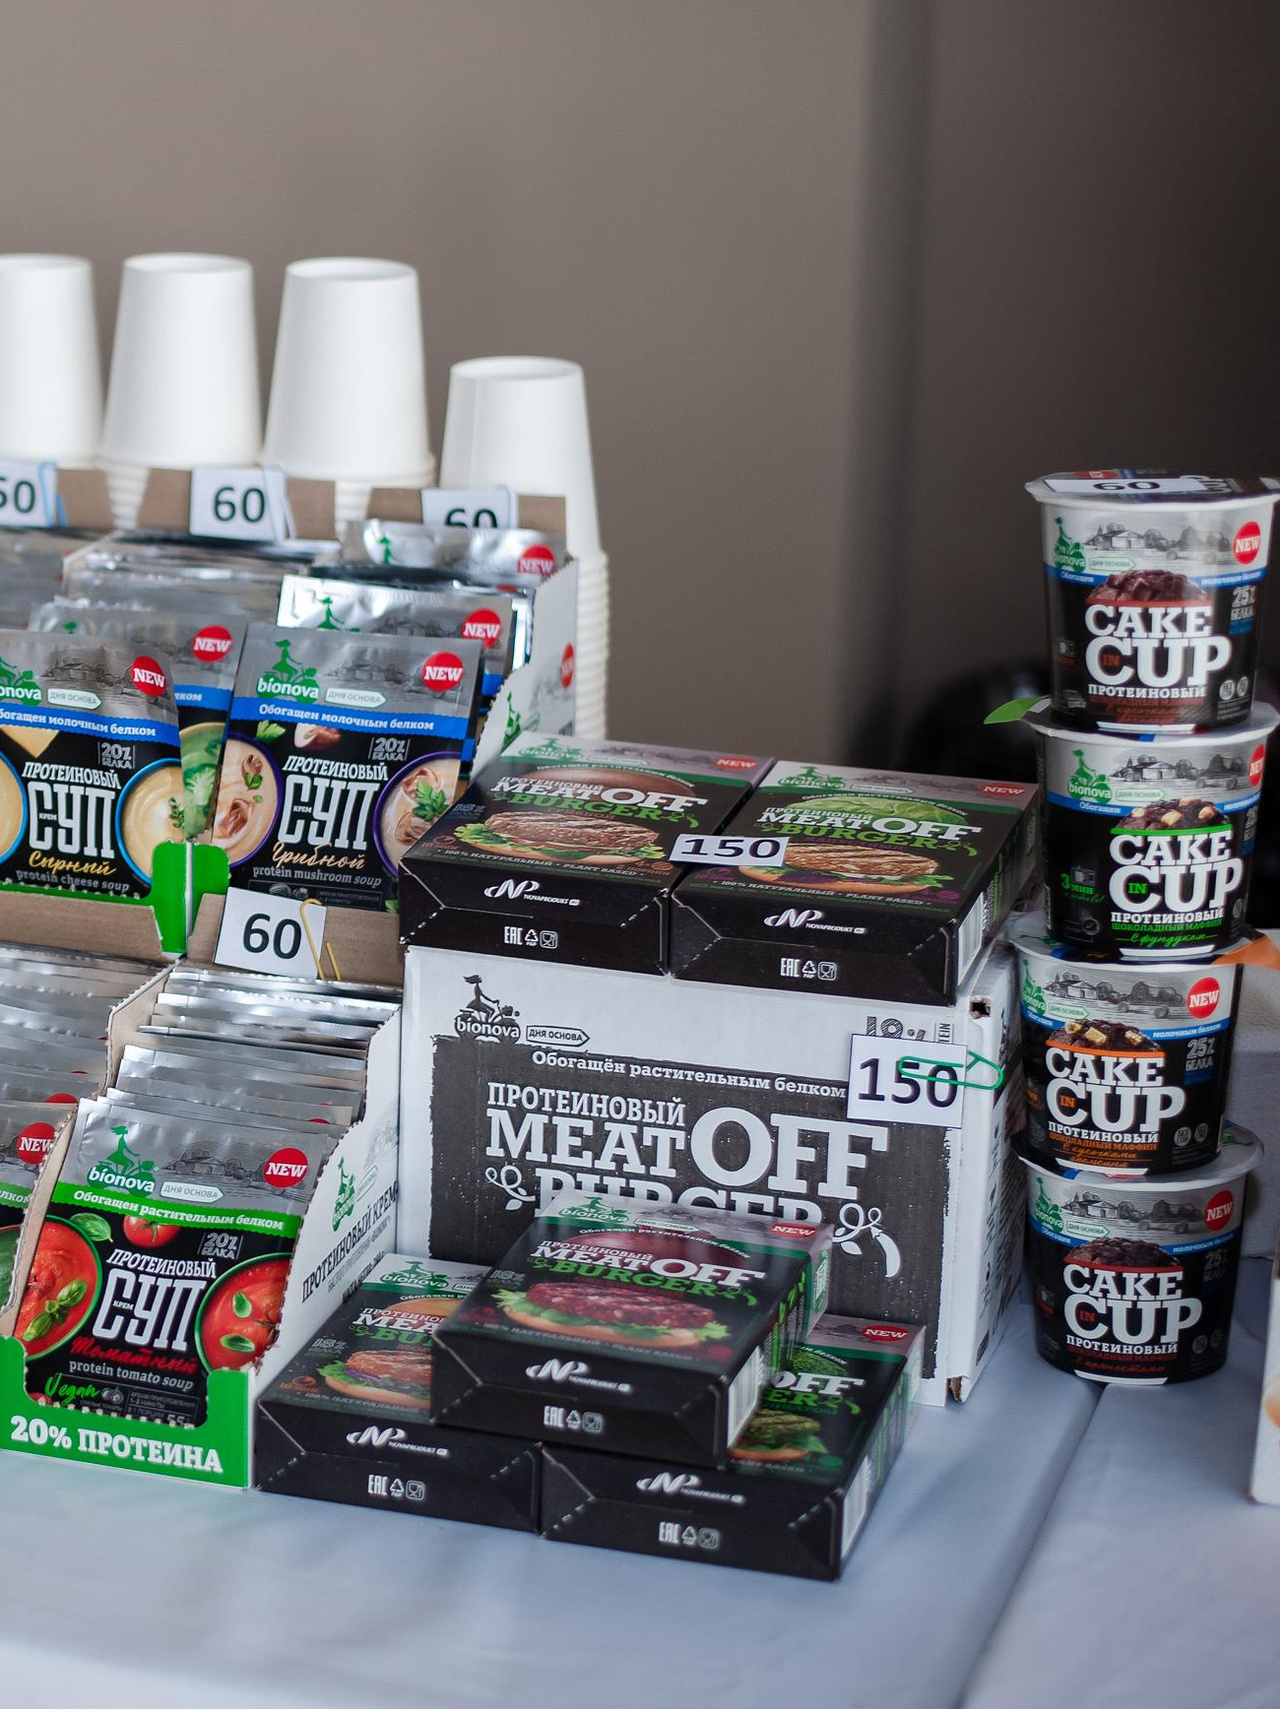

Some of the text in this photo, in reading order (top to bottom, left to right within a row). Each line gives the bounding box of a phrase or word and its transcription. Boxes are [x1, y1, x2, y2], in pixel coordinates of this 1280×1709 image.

[213, 486, 266, 523] 60
[1235, 536, 1260, 553] NEW
[464, 623, 501, 640] NEW
[1085, 604, 1213, 638] CAKE
[193, 636, 233, 655] NEW
[423, 665, 464, 683] NEW
[1085, 636, 1232, 688] CUP
[133, 668, 166, 690] NEW
[257, 677, 320, 701] bionova
[1088, 683, 1207, 698] ПРОТЕИНОВЫЙ
[50, 691, 99, 706] ДНЯ ОСНОВА
[328, 690, 382, 705] ДНЯ ОСНОВА
[48, 714, 109, 734] молочным
[110, 721, 157, 738] белком
[259, 703, 435, 731] Обогащен молочным белком
[101, 742, 132, 760] 20%
[372, 750, 405, 762] БЕЛКА
[373, 737, 406, 754] 20%
[101, 757, 133, 770] БЕЛКА
[282, 754, 389, 782] ПРОТЕИНОВЫЙ
[716, 758, 757, 770] NEW
[22, 761, 123, 791] ПРОТЕИНОВЫЙ
[984, 784, 1025, 796] NEW
[277, 773, 381, 851] СУП
[507, 791, 666, 821] BURGER
[27, 780, 116, 859] СУП
[680, 837, 781, 859] 150
[776, 822, 941, 851] BURGER
[1109, 830, 1233, 866] CAKE
[28, 850, 117, 877] Сырный
[271, 840, 366, 871] Грибной
[16, 868, 131, 893] protein cheese soup
[253, 864, 382, 890] protein mushroom soup
[1109, 858, 1244, 913] CUP
[1128, 882, 1147, 895] IN
[1111, 908, 1224, 924] ПРОТЕИНОВЫЙ
[242, 912, 302, 960] 60
[1189, 990, 1220, 1009] NEW
[455, 1015, 520, 1039] bionova
[528, 1028, 584, 1042] ДНЯ ОСНОВА
[532, 1050, 847, 1099] Обогащён растительным белком
[1045, 1047, 1165, 1087] CAKE
[858, 1057, 959, 1108] 150
[487, 1081, 686, 1127] ПРОТЕИНОВЫЙ
[1046, 1078, 1186, 1133] CUP
[1059, 1095, 1076, 1109] IN
[1048, 1120, 1159, 1143] ПРОТЕИНОВЫЙ
[88, 1166, 156, 1194] bionova
[265, 1161, 308, 1179] NEW
[163, 1184, 220, 1200] ДНЯ ОСНОВА
[73, 1189, 285, 1231] Обогащен растительным белком
[1206, 1201, 1233, 1222] NEW
[773, 1225, 816, 1238] NEW
[200, 1246, 237, 1260] БЕЛКА
[540, 1239, 653, 1261] ПРОТЕИНОВЫЙ
[106, 1247, 218, 1280] ПРОТЕИНОВЫЙ
[552, 1260, 725, 1297] BURGER
[1063, 1264, 1184, 1301] CAKE
[92, 1267, 208, 1353] СУП
[1063, 1293, 1203, 1346] CUP
[1078, 1309, 1095, 1323] IN
[864, 1327, 909, 1339] NEW
[1066, 1334, 1178, 1355] ПРОТЕИНОВЫЙ
[69, 1360, 194, 1393] protein tomato soup
[10, 1414, 224, 1475] 20% ПРОТЕИНА
